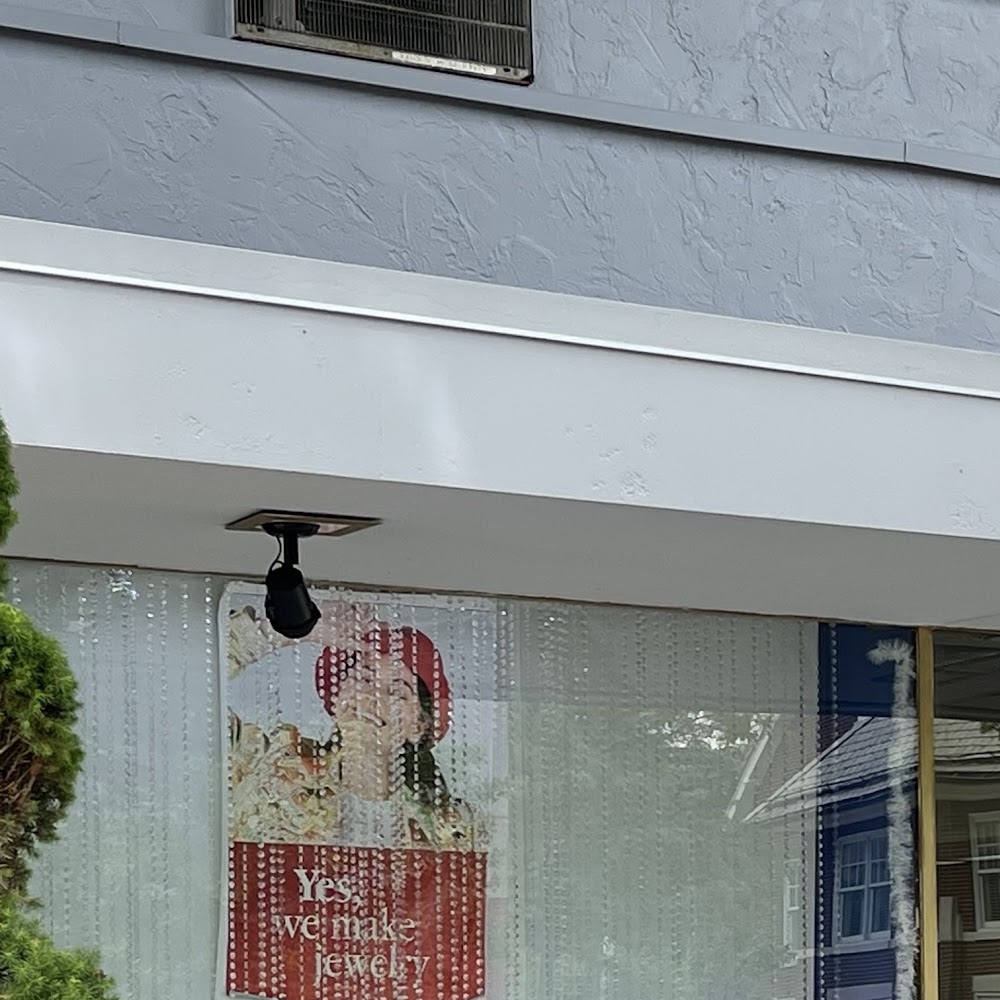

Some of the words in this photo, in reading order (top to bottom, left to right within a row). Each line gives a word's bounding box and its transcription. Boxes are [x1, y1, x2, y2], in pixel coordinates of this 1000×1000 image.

[293, 867, 362, 907] Yes,
[274, 912, 322, 941] we
[331, 906, 417, 943] make
[313, 940, 431, 987] jewelry
